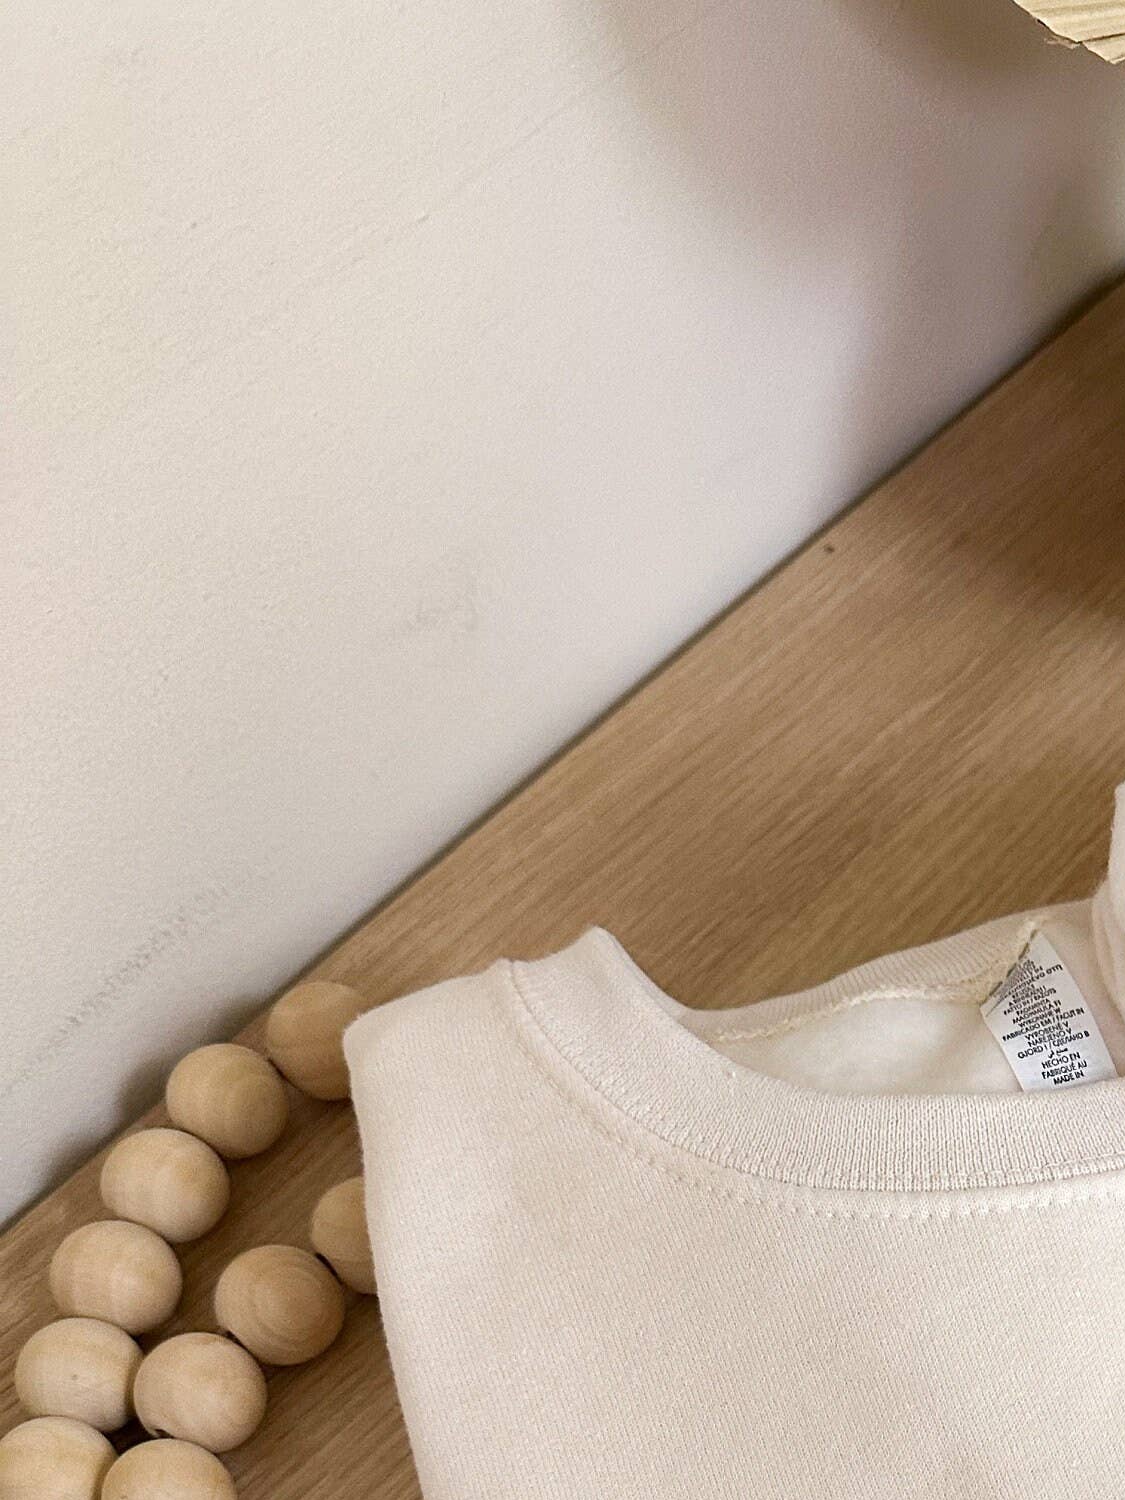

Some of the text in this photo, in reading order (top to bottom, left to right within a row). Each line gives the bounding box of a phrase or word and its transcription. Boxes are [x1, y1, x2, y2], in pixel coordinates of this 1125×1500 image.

[1042, 1052, 1080, 1069] HECHO EN
[1076, 1060, 1087, 1070] AU
[1054, 1070, 1084, 1085] MADE IN
